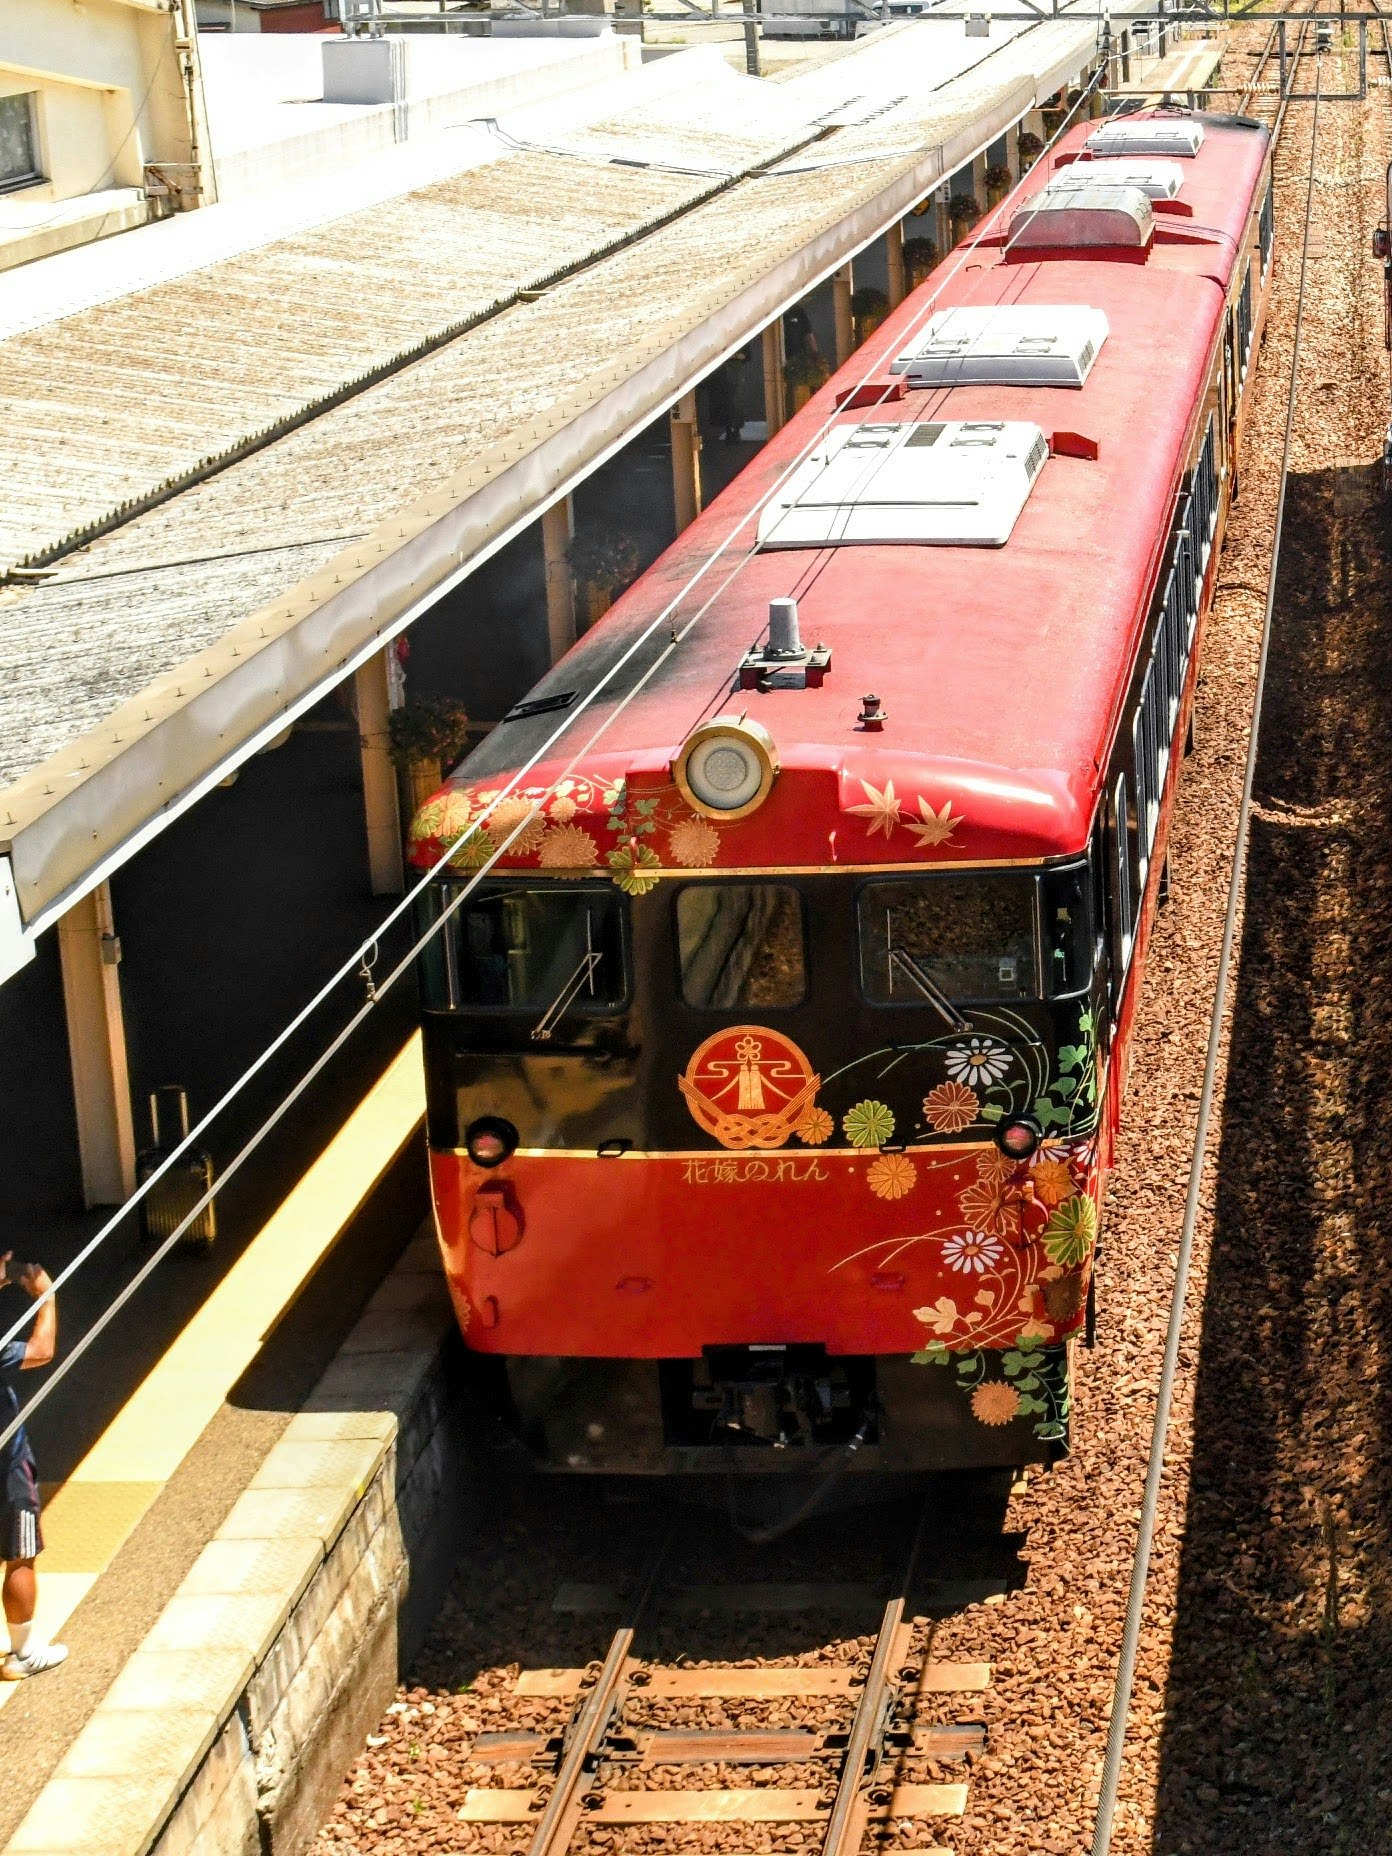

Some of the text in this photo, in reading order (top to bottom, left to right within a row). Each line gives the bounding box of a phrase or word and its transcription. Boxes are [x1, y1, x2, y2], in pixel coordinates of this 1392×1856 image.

[681, 1158, 830, 1184] 花嫁のれん
